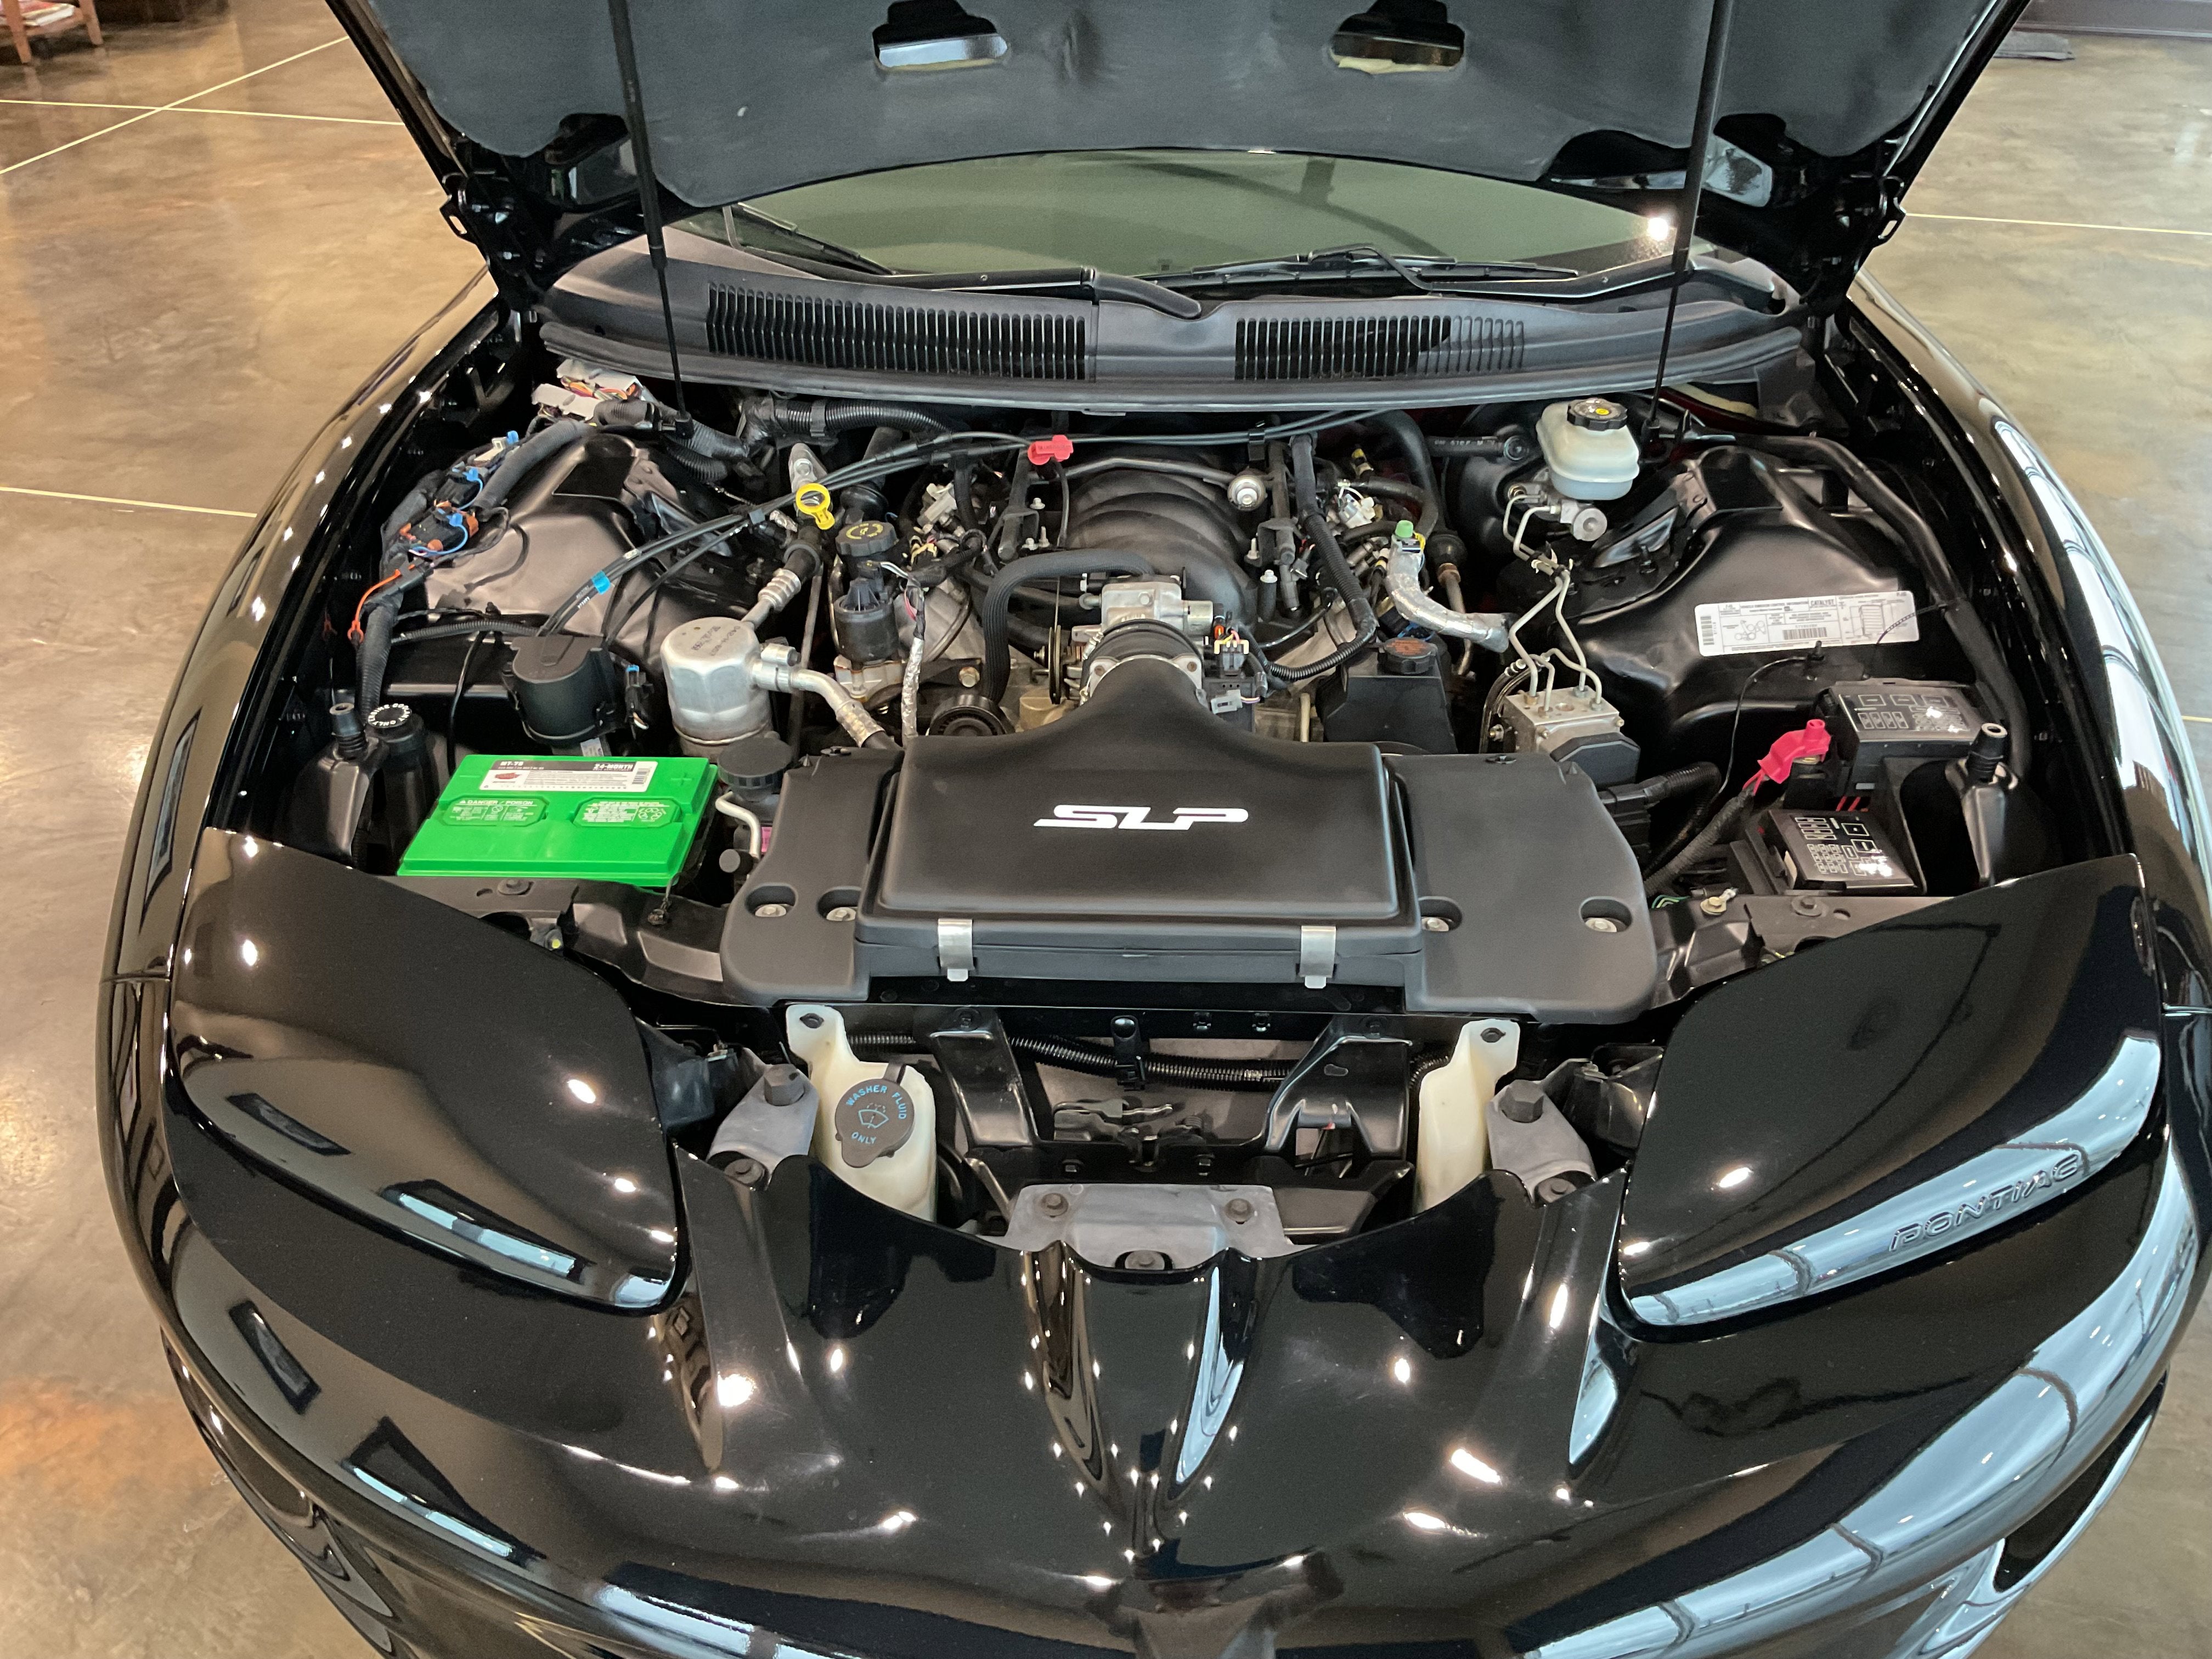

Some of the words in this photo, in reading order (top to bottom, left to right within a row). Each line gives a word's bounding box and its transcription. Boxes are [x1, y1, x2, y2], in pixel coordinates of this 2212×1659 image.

[368, 704, 390, 722] ENGINE
[392, 703, 410, 721] COOLANT
[1034, 805, 1249, 830] SLP
[846, 1085, 887, 1106] WASHER
[892, 1092, 907, 1119] FLUID
[851, 1132, 877, 1144] ONLY
[1889, 1150, 2082, 1251] PONTIAC
